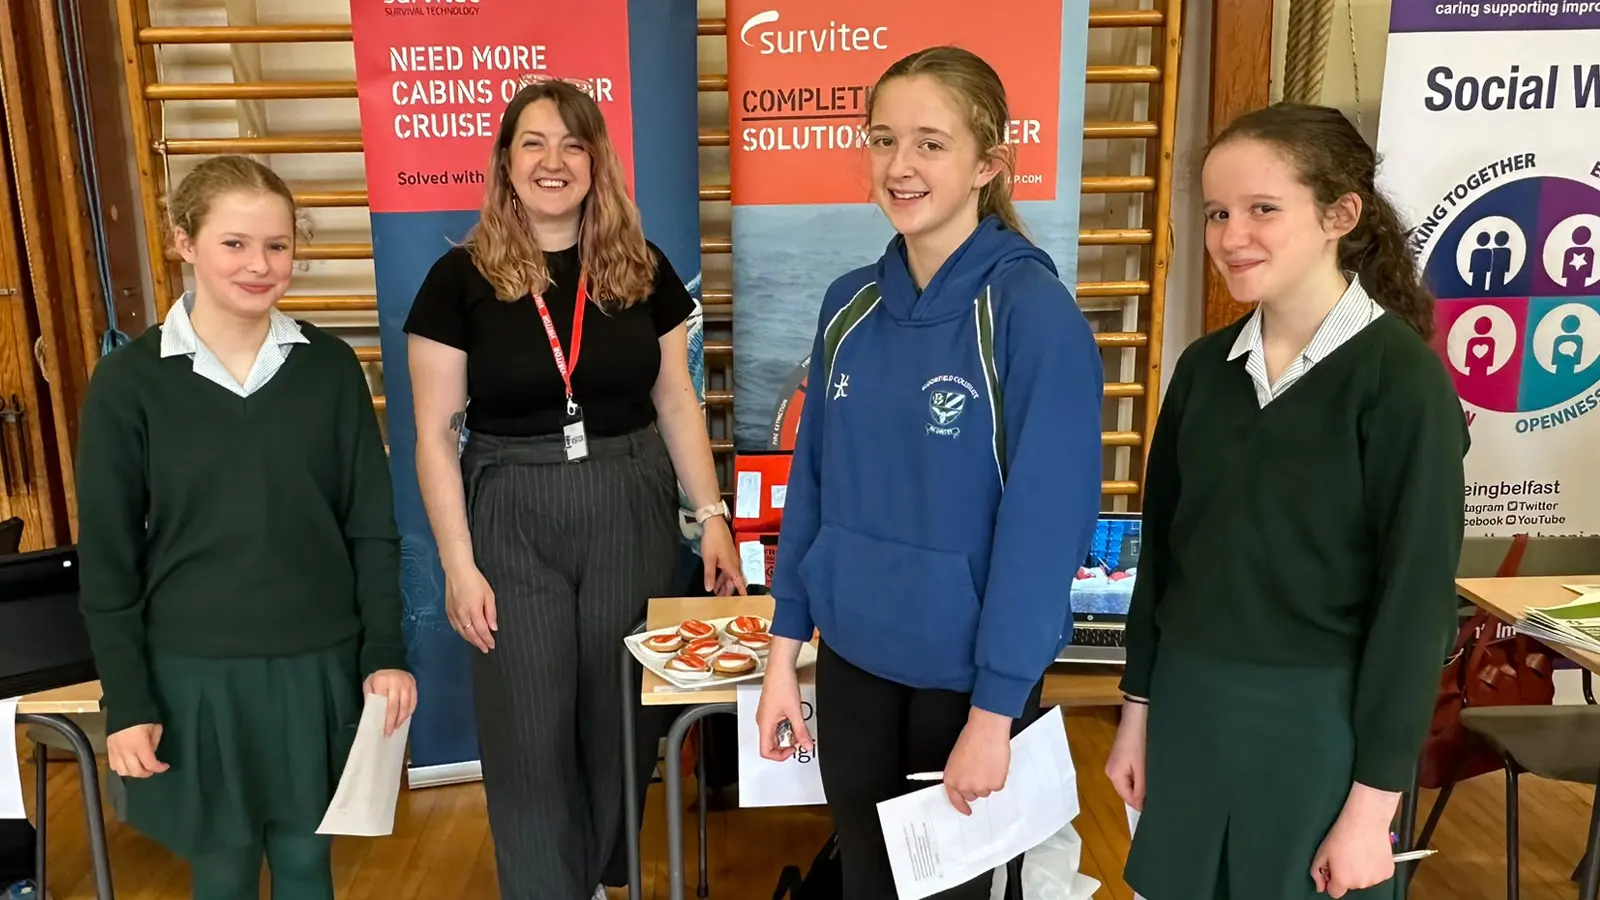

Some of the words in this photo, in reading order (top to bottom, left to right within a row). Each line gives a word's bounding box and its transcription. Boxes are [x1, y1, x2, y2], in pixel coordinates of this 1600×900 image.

[385, 7, 424, 17] SURVIVAL
[426, 6, 480, 16] TECHNOLOGY
[1435, 1, 1480, 17] caring
[1483, 0, 1558, 16] supporting
[760, 21, 887, 54] survitec
[390, 46, 463, 71] NEED
[472, 45, 547, 70] MORE
[392, 79, 493, 105] CABINS
[1424, 65, 1558, 112] Social
[394, 112, 493, 138] CRUISE
[397, 172, 448, 185] Solved
[452, 171, 484, 184] with
[1443, 152, 1536, 207] TOGETHER
[553, 346, 567, 376] VISITOR
[1519, 501, 1558, 511] Twitter
[1518, 515, 1566, 525] YouTube
